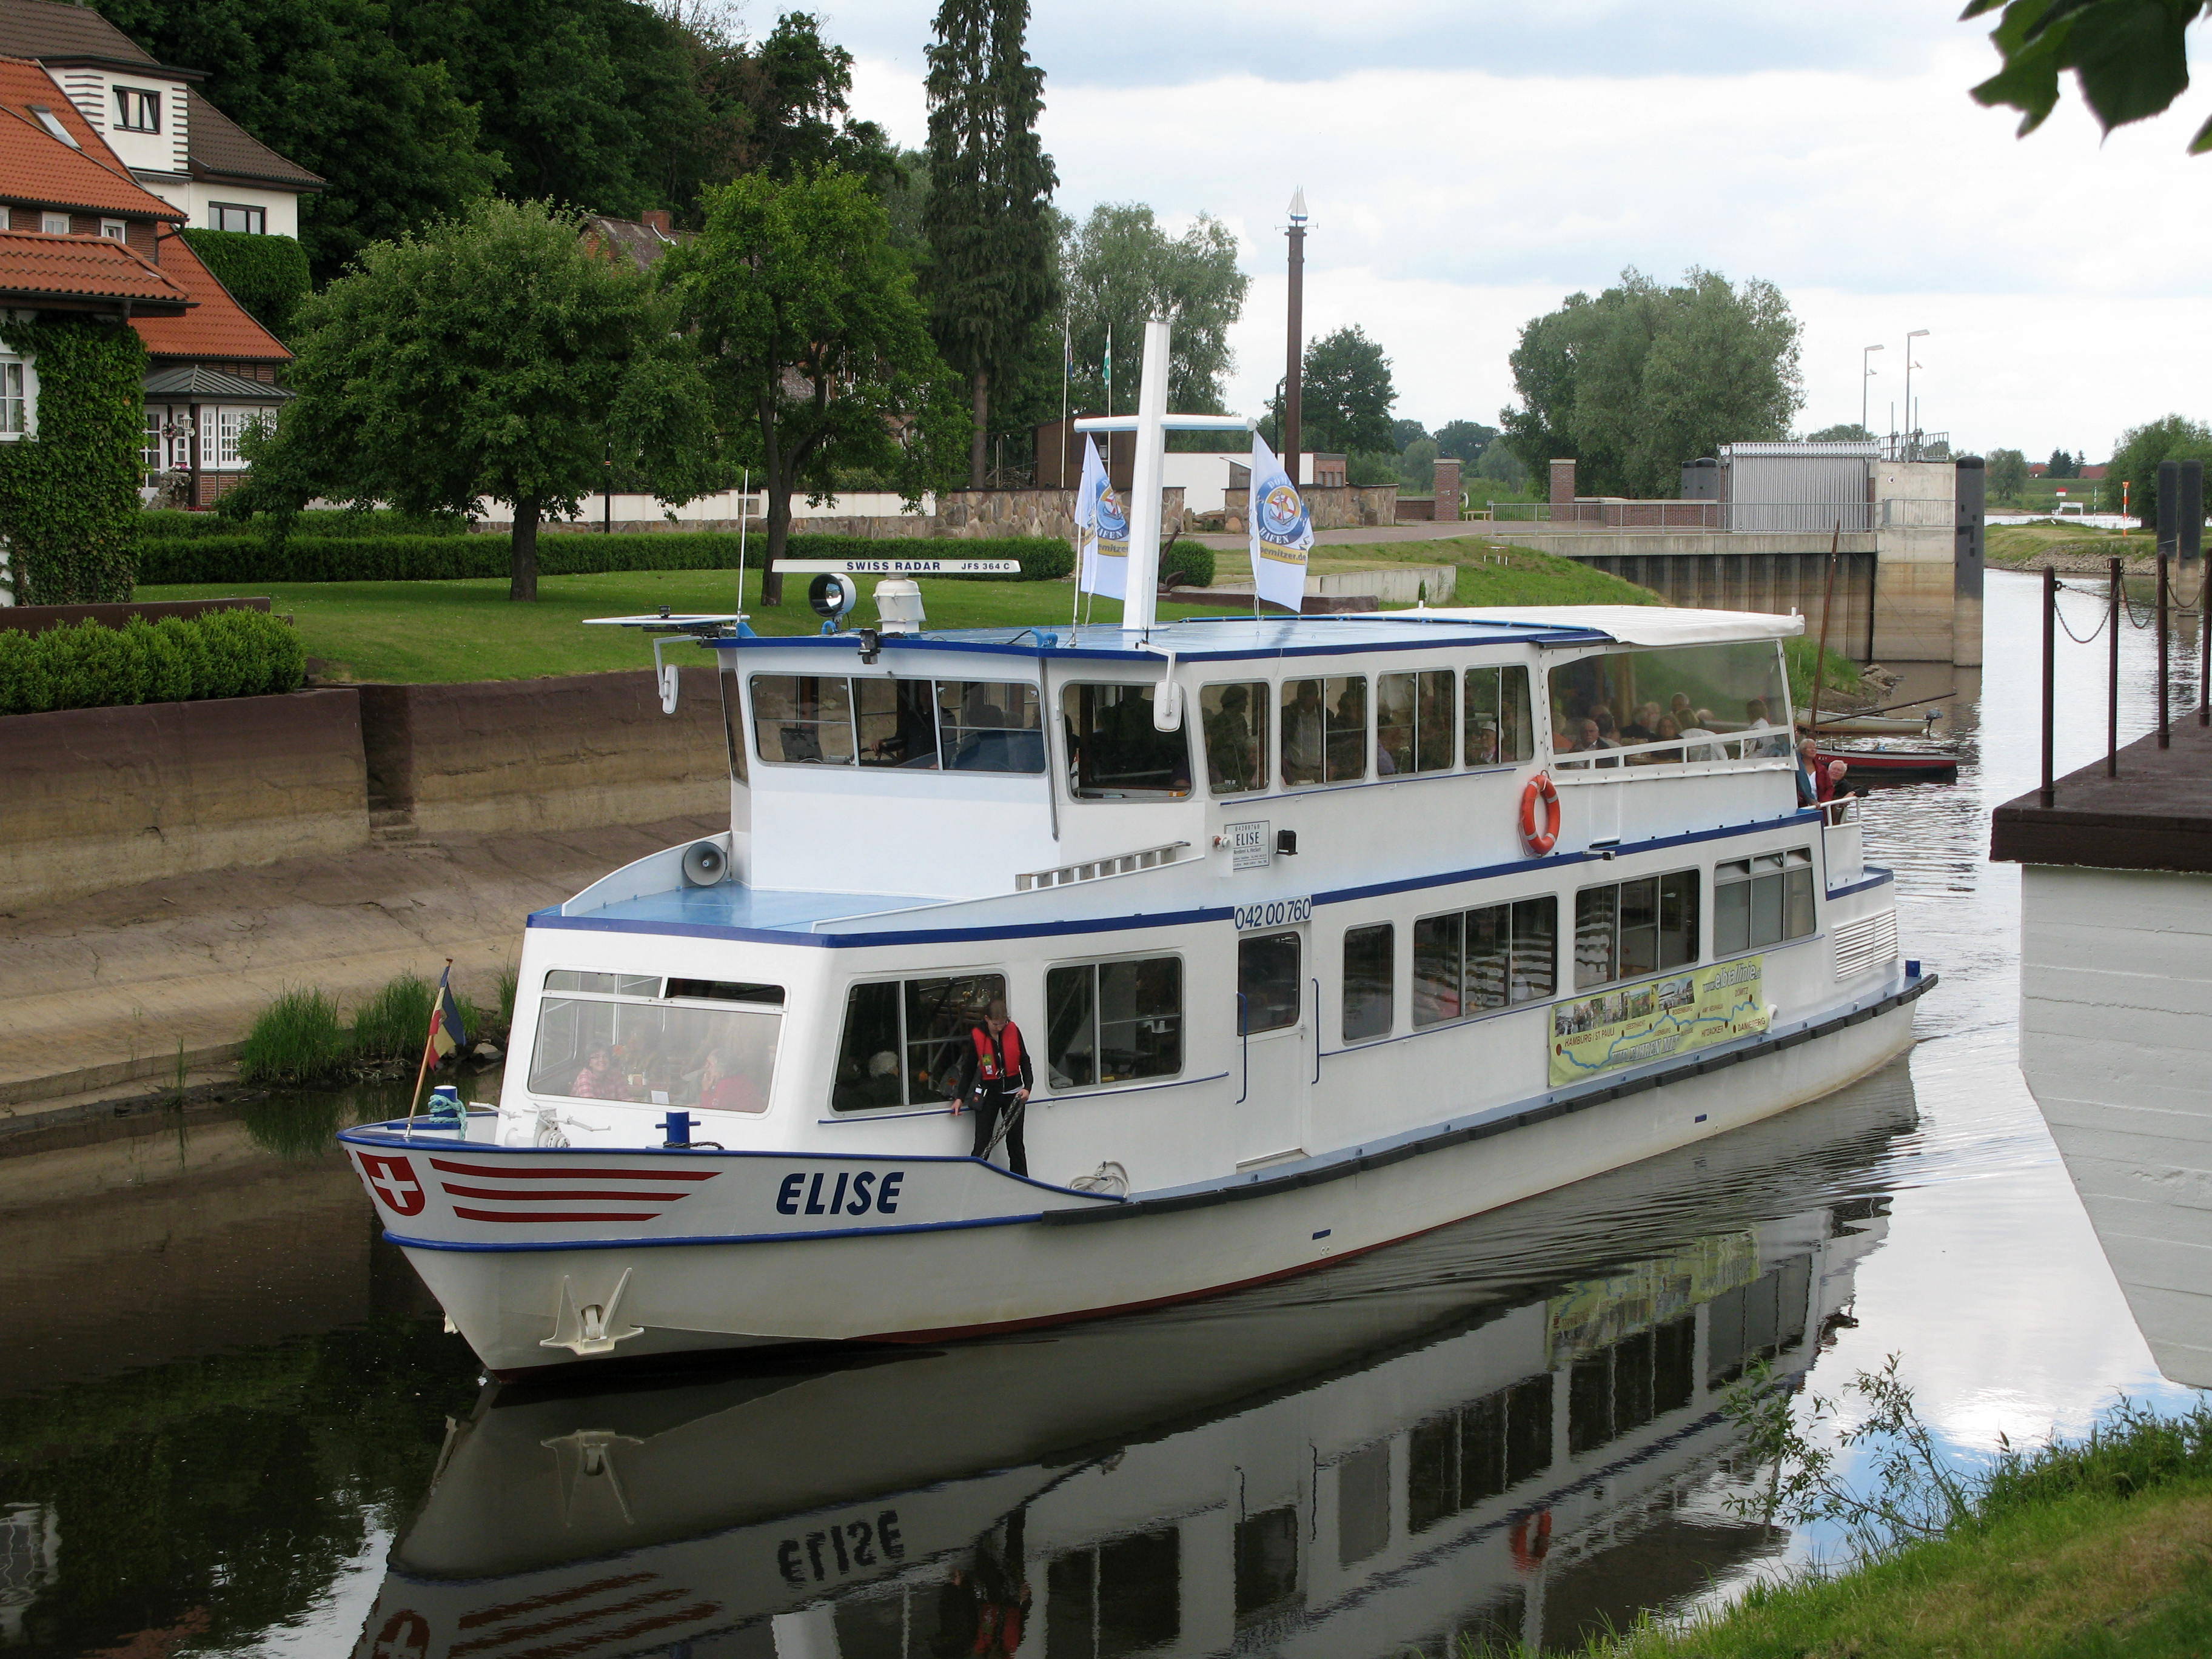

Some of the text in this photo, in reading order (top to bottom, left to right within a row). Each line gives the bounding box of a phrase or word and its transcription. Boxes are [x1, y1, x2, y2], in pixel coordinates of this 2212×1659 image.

[1259, 526, 1289, 545] HAFEN
[1098, 543, 1128, 553] emitze
[846, 561, 941, 571] SWISS RADAR
[1236, 831, 1259, 846] ELISE
[1235, 898, 1311, 930] 042 00 760
[1565, 1033, 1592, 1048] HAMBURG
[776, 1171, 904, 1215] ELISE
